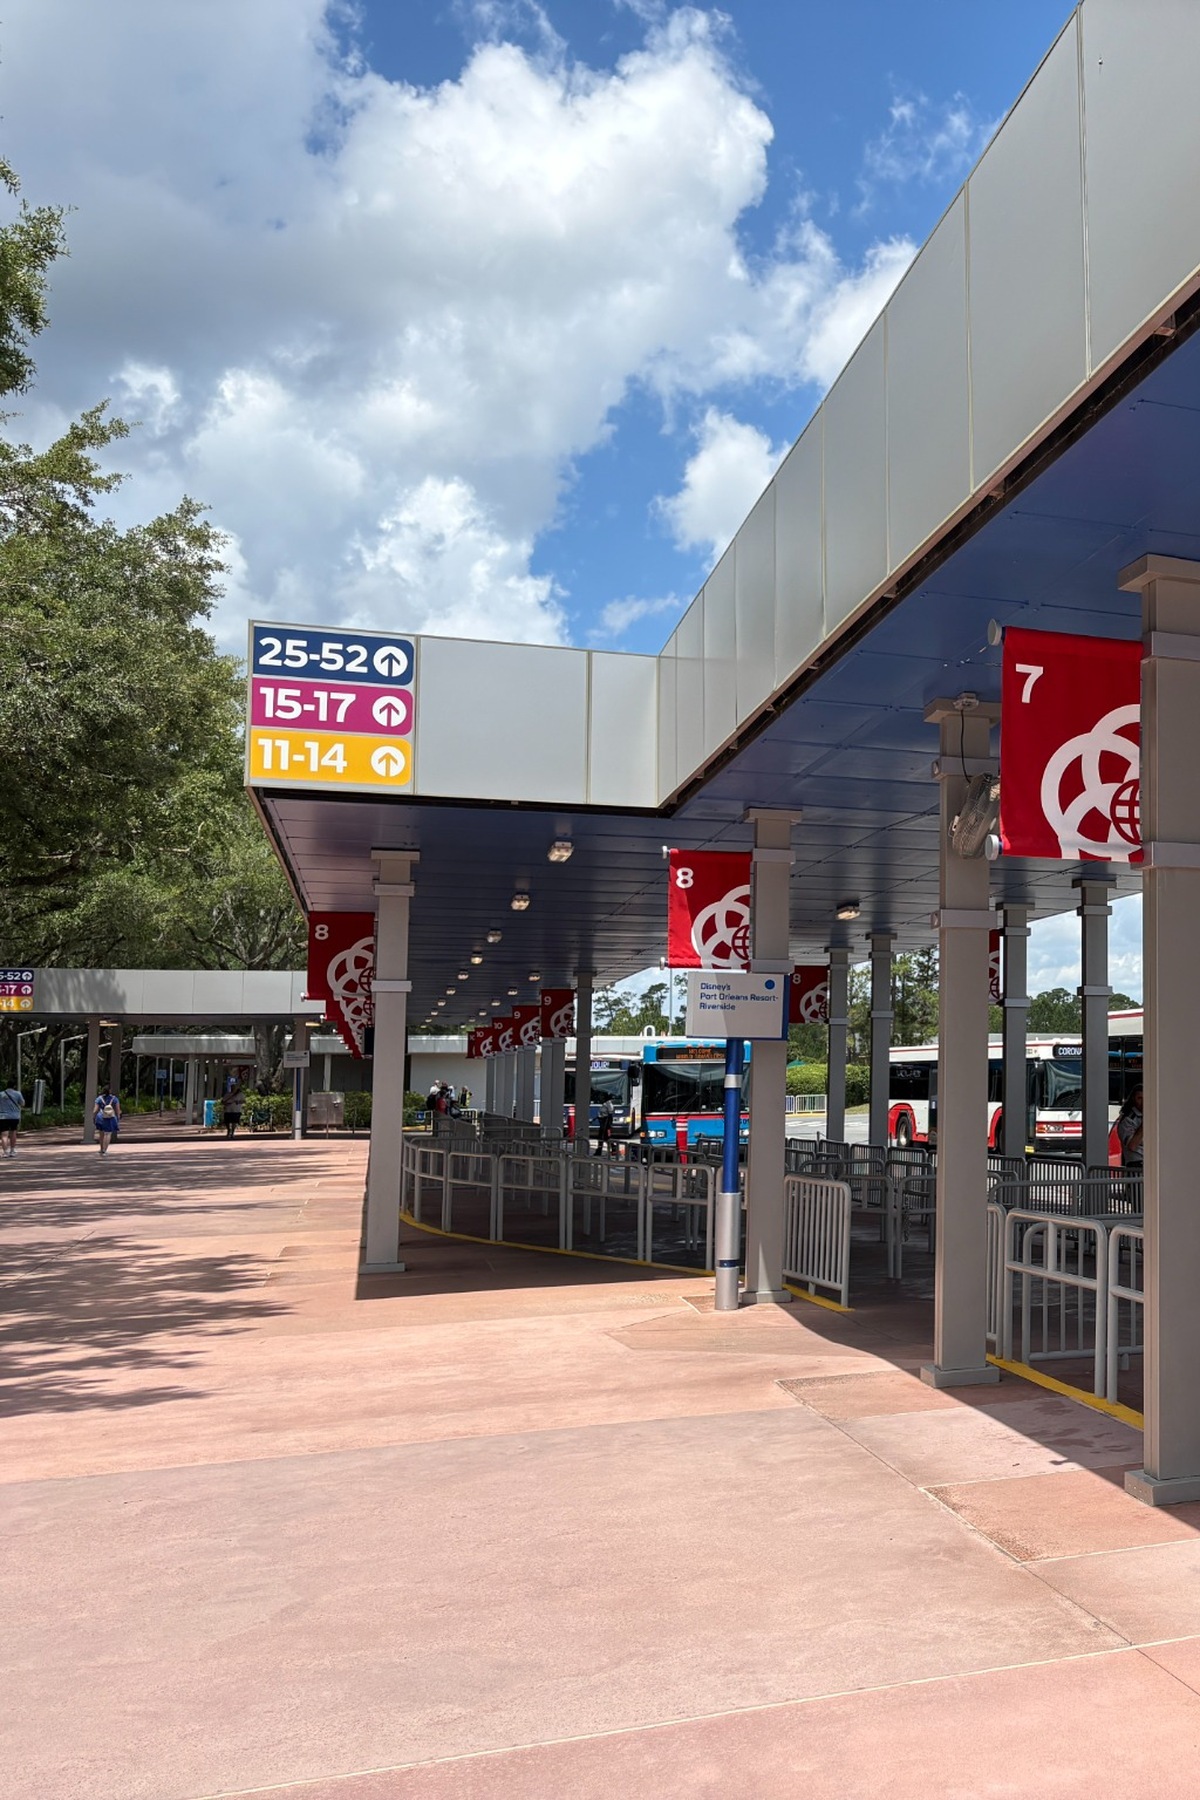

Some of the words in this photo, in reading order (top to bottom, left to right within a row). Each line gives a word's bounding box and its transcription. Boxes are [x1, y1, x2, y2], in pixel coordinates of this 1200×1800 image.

[258, 637, 368, 674] 25-52
[1015, 663, 1044, 704] 7
[259, 686, 357, 723] 15-17
[257, 738, 348, 773] 11-14
[675, 867, 694, 889] 8
[314, 924, 329, 940] 8
[0, 971, 21, 981] 5-52
[792, 973, 801, 985] 8
[543, 996, 552, 1006] 9
[700, 992, 717, 1001] Port
[719, 993, 749, 1001] Orleans
[699, 1002, 736, 1011] Riverside
[513, 1011, 521, 1019] 9
[493, 1022, 503, 1030] 10
